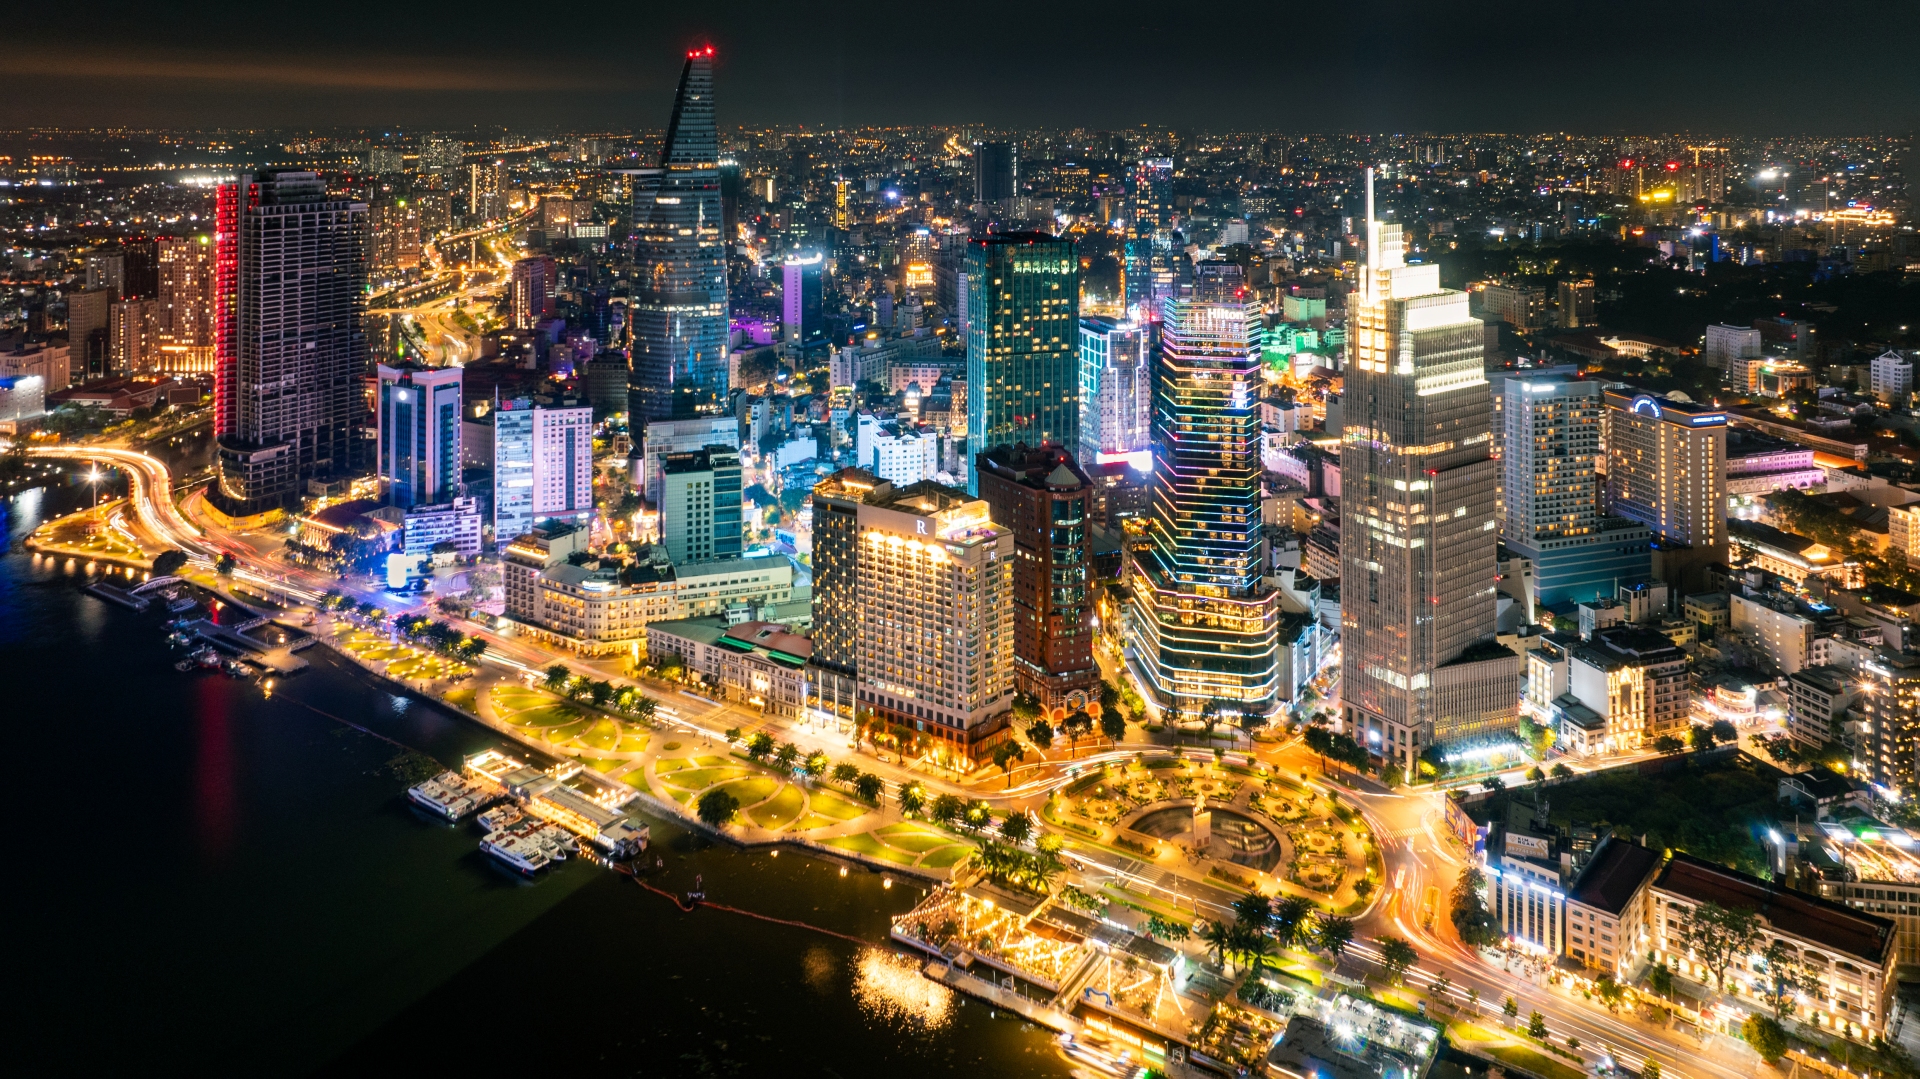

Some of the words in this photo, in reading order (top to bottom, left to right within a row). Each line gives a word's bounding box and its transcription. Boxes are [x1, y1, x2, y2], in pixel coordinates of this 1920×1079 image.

[1207, 308, 1244, 320] Hilton
[916, 519, 928, 535] R
[990, 551, 996, 560] R
